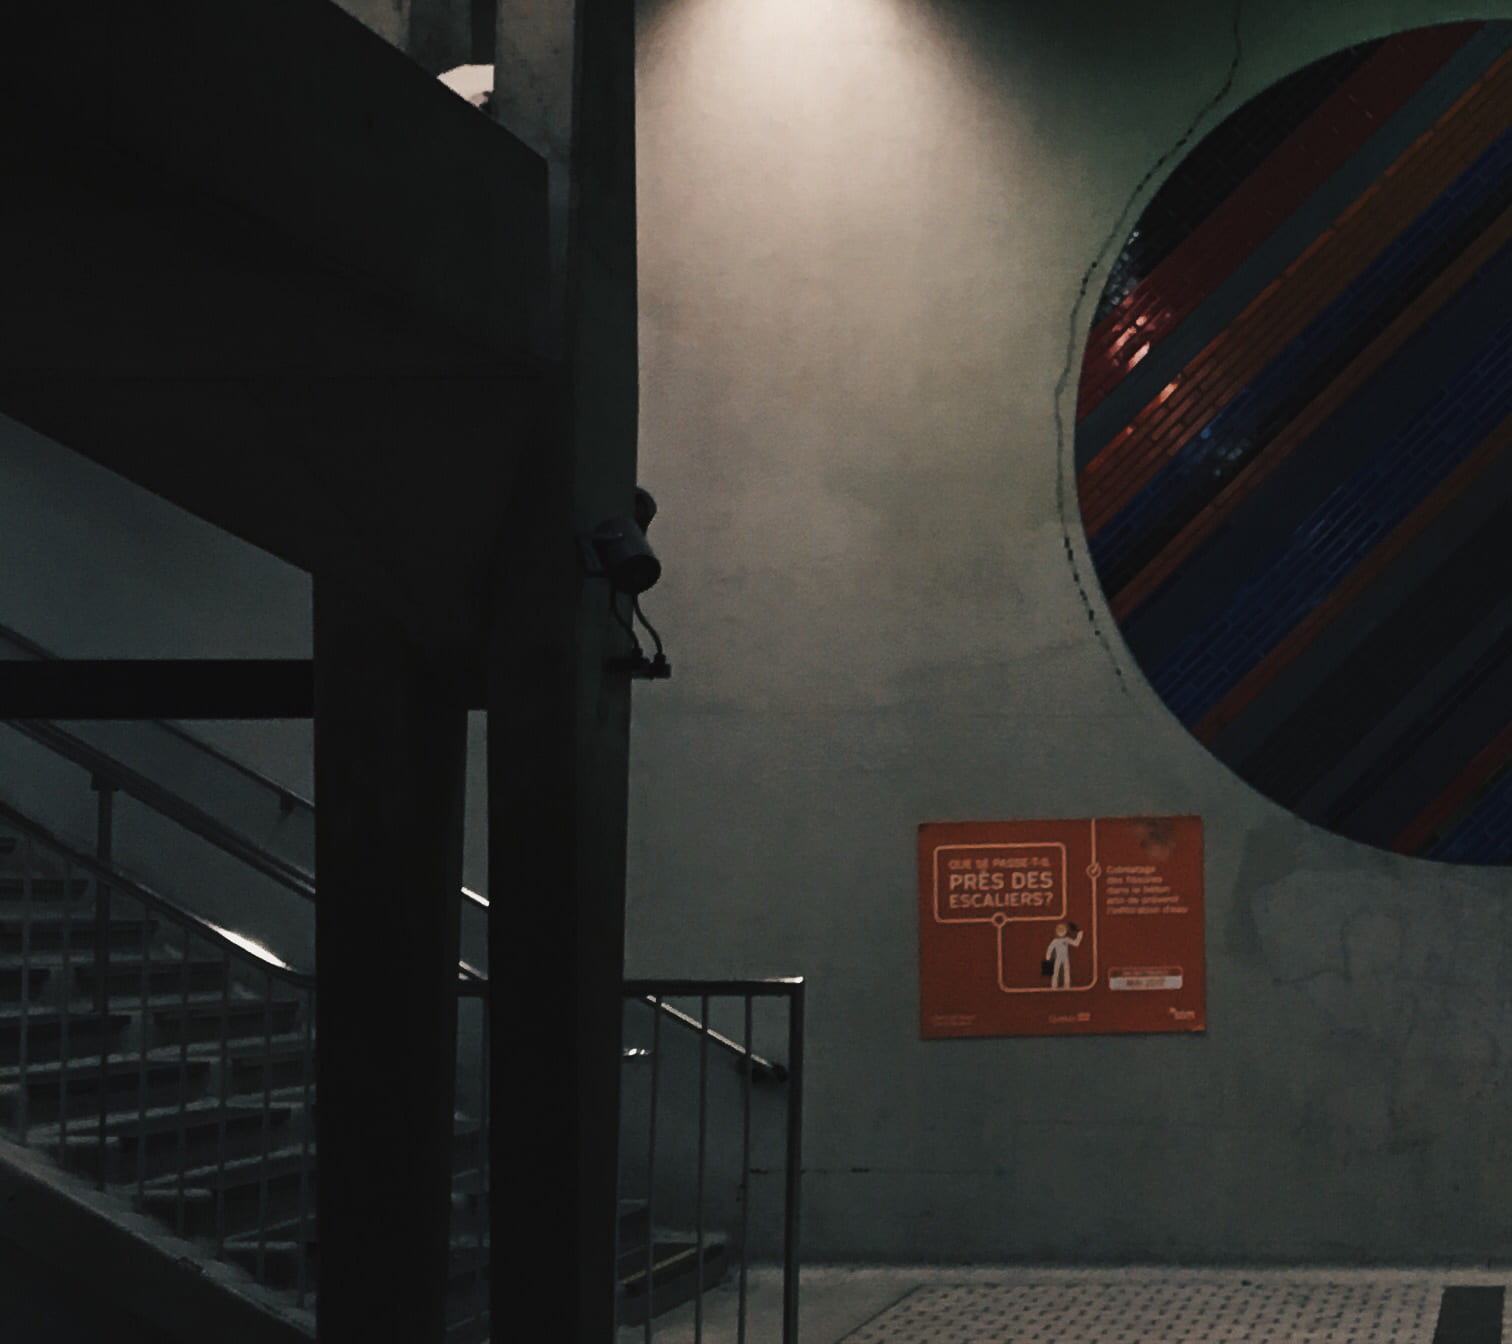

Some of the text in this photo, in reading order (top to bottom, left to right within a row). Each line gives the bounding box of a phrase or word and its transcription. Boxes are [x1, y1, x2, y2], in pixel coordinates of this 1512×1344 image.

[949, 870, 1053, 890] PRÈS DES
[949, 892, 1053, 909] ESCALIERS?
